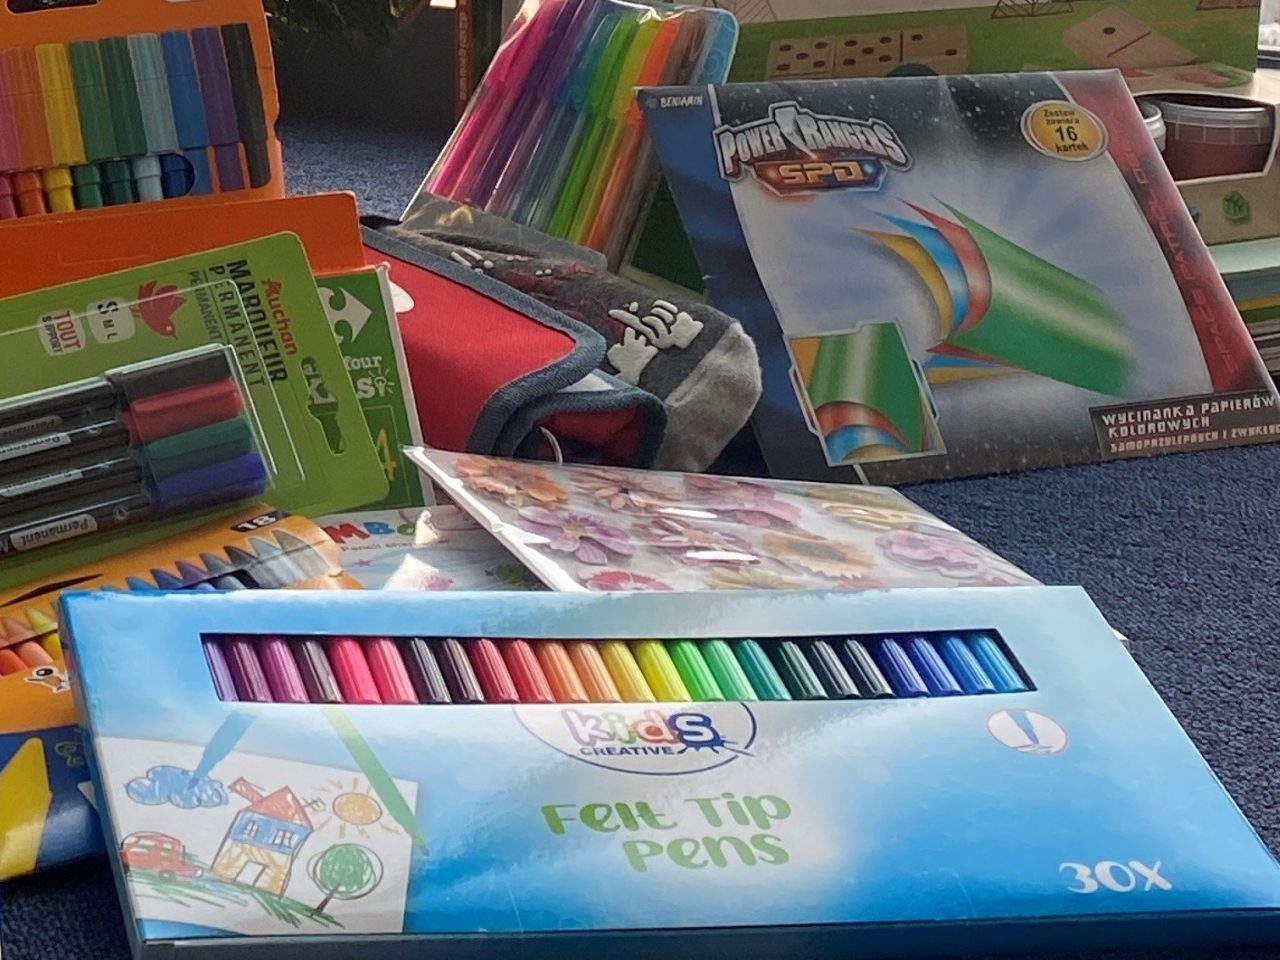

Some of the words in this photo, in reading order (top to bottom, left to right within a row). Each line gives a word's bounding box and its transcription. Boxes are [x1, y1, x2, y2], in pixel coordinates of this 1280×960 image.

[721, 119, 784, 174] POWER
[803, 113, 908, 165] RANGERS
[1055, 126, 1078, 142] 16
[54, 310, 81, 349] TOUT
[209, 265, 267, 387] PERMANENT
[261, 277, 298, 356] Auchan
[1102, 404, 1195, 426] WYCINANKA
[1201, 394, 1276, 415] PAPIERÓW
[1108, 416, 1211, 439] KOLOROWYCH
[21, 518, 90, 547] Permanent
[237, 513, 277, 532] 18
[580, 746, 676, 757] CREATIVE
[541, 801, 678, 836] Felt
[684, 792, 792, 831] Tip
